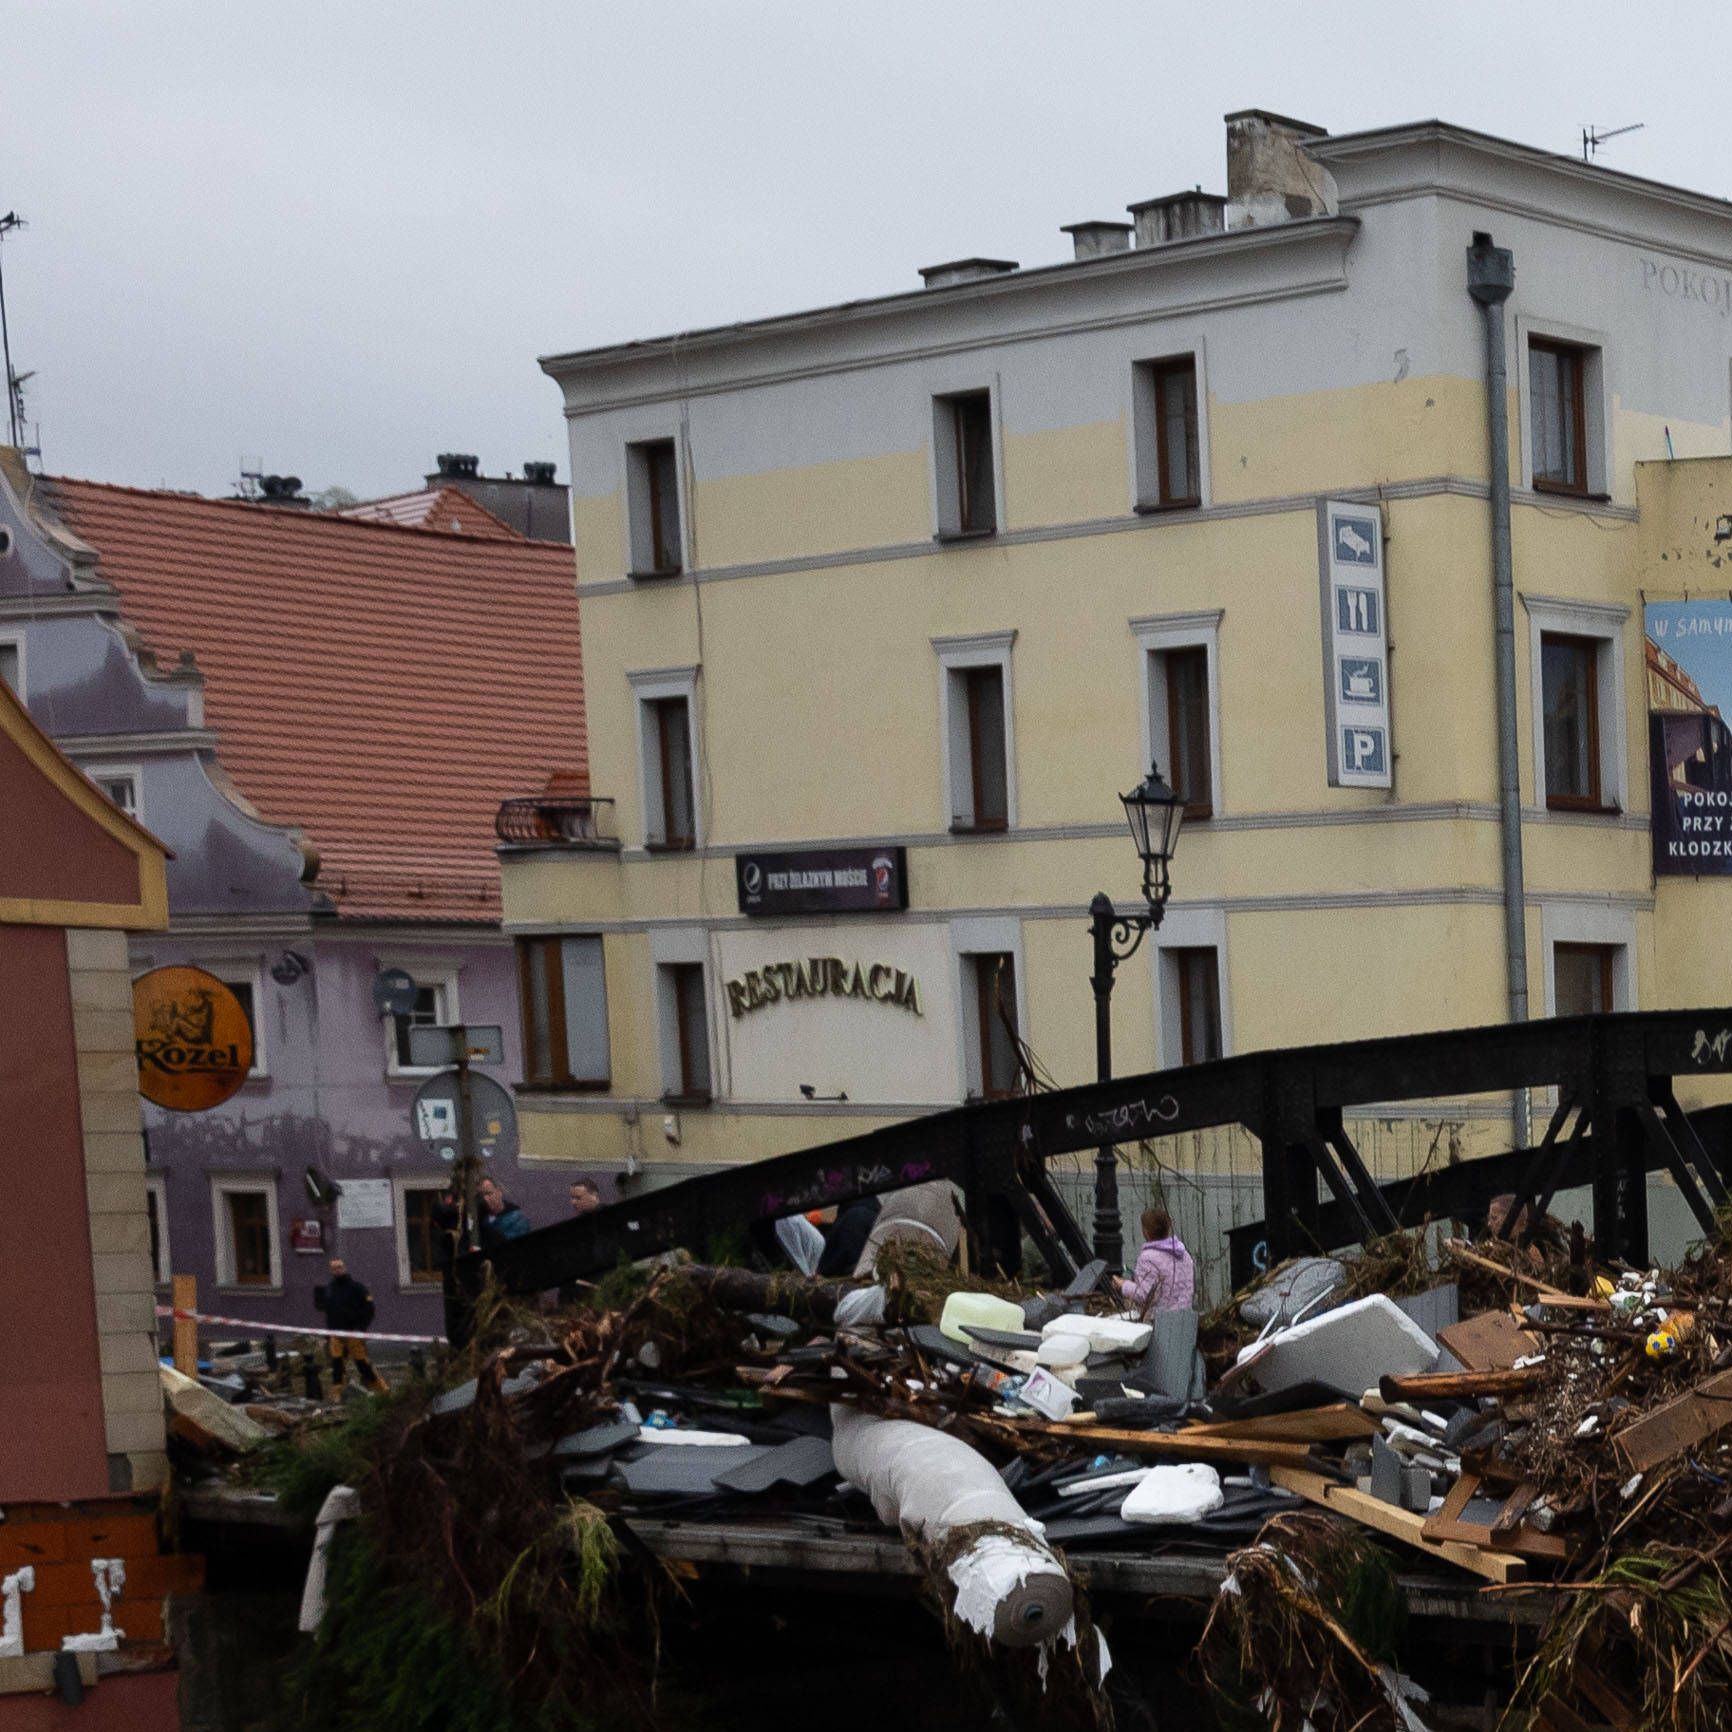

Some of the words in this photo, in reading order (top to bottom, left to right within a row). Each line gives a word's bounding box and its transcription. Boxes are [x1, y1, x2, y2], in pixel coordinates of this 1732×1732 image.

[1654, 618, 1669, 638] W
[1354, 733, 1375, 768] P
[1682, 816, 1724, 832] PRZY
[727, 957, 925, 1018] RESTAURACJA
[136, 1039, 239, 1075] Kozel
